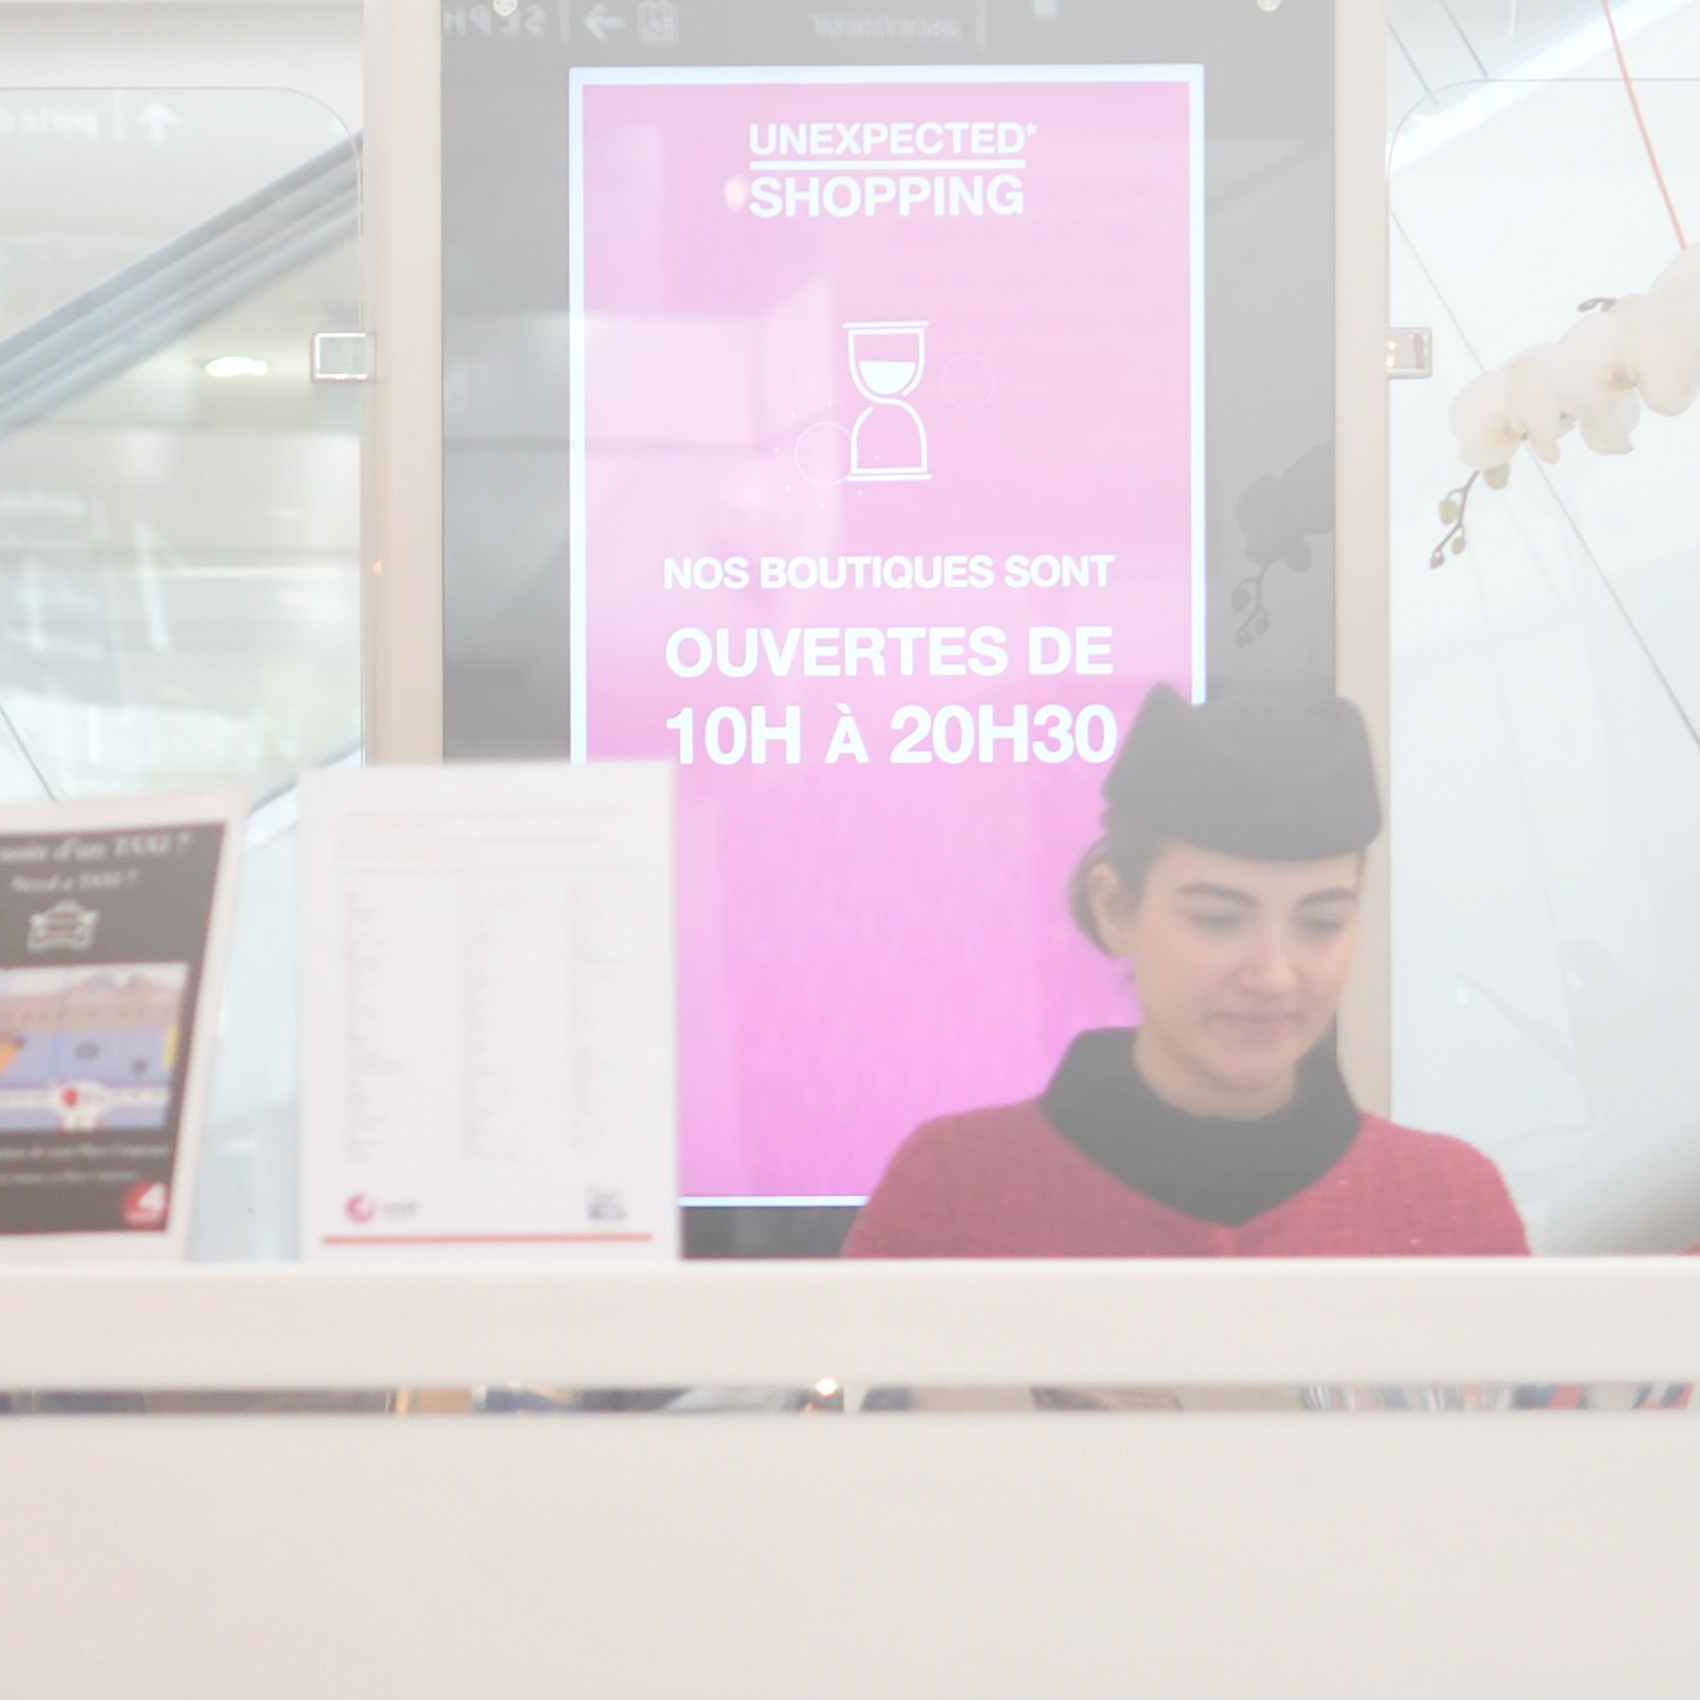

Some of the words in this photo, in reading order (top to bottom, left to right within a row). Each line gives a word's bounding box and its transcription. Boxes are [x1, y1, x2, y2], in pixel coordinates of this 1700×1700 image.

[749, 173, 1025, 218] SHOPPING
[663, 556, 749, 590] NOS
[760, 555, 995, 591] BOUTIQUES
[1004, 554, 1115, 588] SONT
[665, 626, 1009, 678] OUVERTES
[1028, 626, 1114, 676] DE
[665, 705, 801, 765] 10H
[824, 703, 870, 764] À
[889, 704, 1117, 764] 20H30
